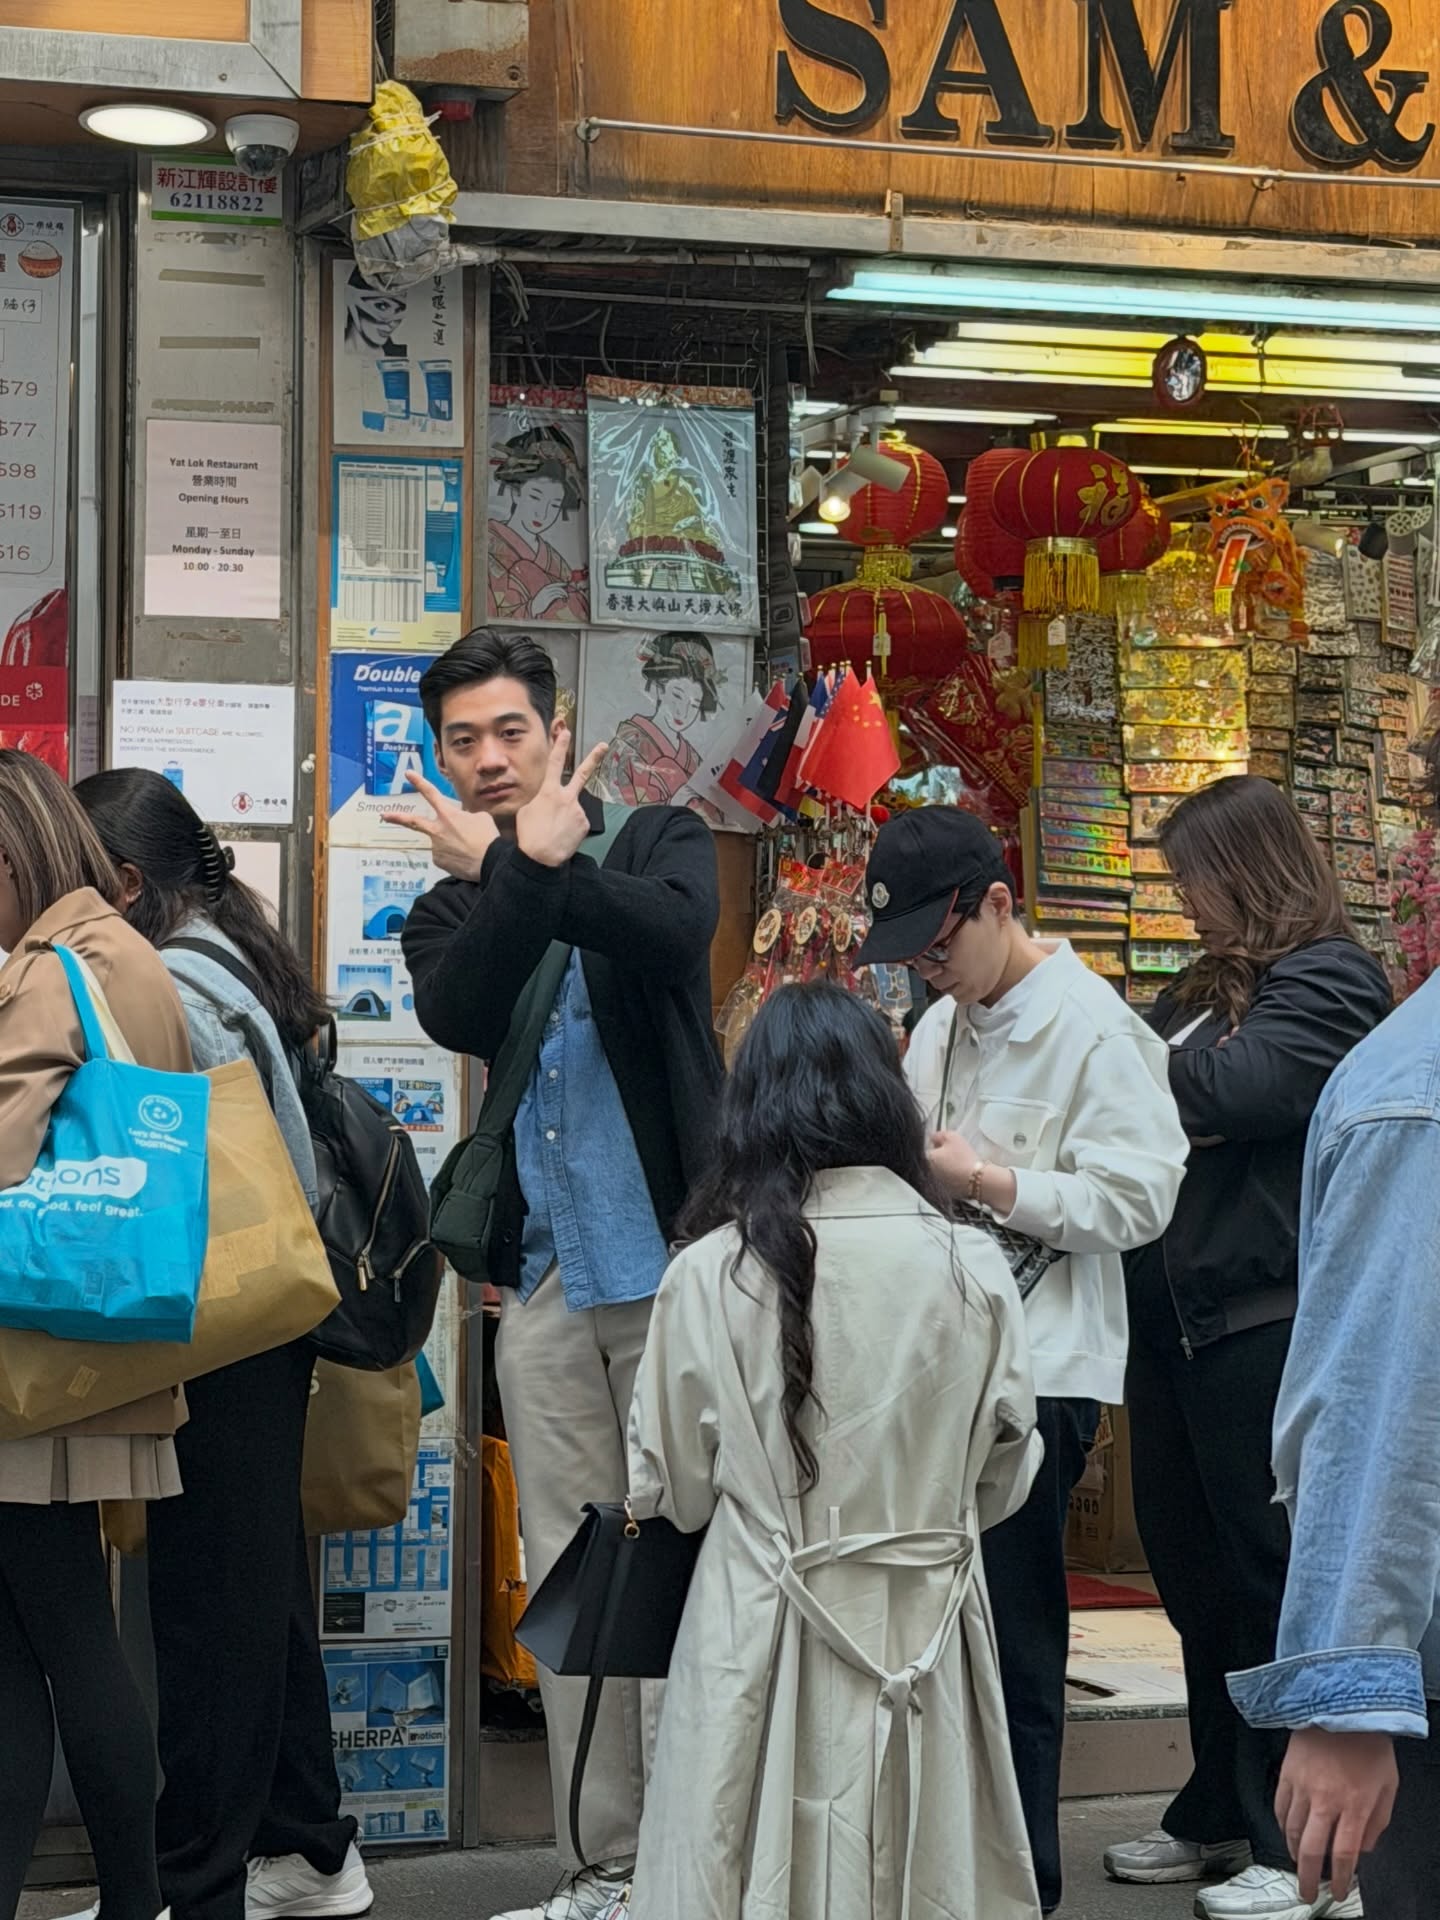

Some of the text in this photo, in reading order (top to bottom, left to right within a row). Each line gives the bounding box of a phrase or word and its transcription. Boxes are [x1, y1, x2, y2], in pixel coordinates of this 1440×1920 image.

[776, 0, 1437, 170] SAM &
[169, 192, 264, 212] 62118822
[0, 377, 38, 396] $79
[170, 458, 258, 470] Yat Lok Restaurant
[192, 474, 237, 488] 營業時間
[178, 493, 249, 505] Opening Hours
[1077, 463, 1134, 528] 福
[185, 526, 241, 540] 星期一至日
[172, 544, 211, 555] Monday
[219, 546, 255, 557] Sunday
[353, 664, 421, 684] Double
[120, 725, 134, 734] NO
[137, 726, 164, 735] PRAM
[176, 727, 220, 737] SUITCASE
[356, 801, 416, 813] Smoother
[104, 1205, 144, 1217] great.
